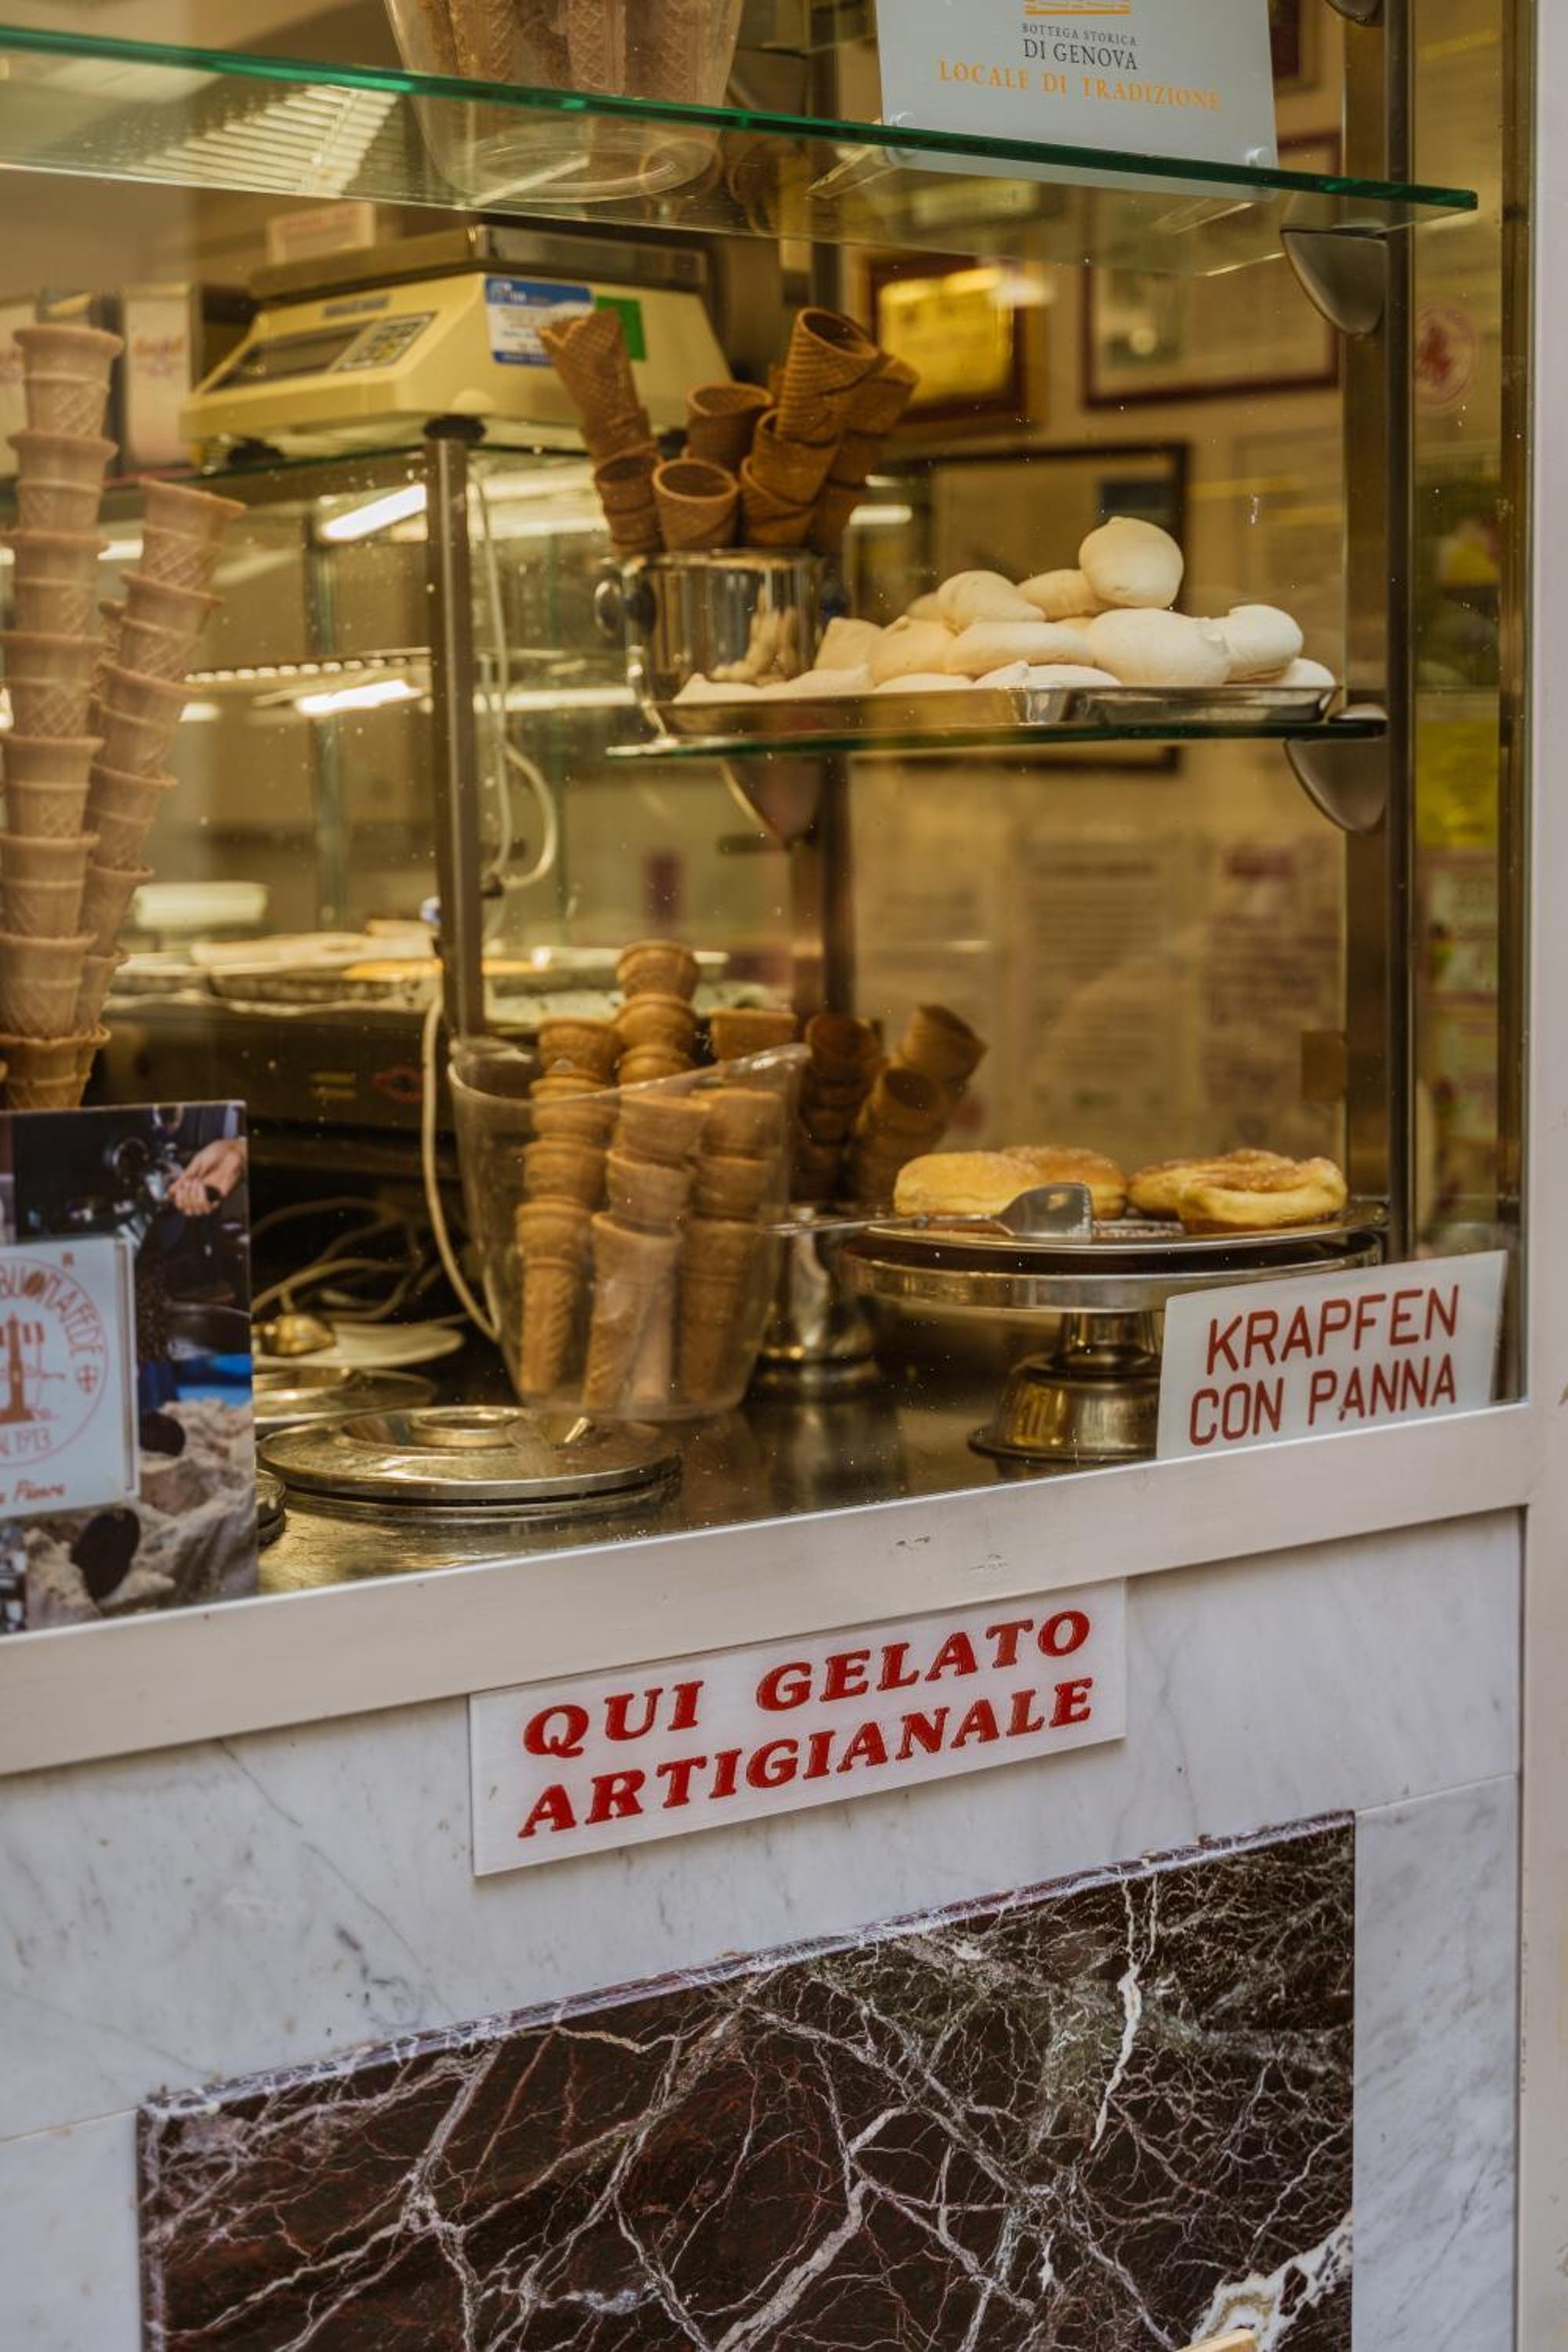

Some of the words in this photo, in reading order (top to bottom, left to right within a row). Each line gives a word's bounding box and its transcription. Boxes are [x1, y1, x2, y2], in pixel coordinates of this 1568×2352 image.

[1022, 23, 1079, 39] BOTTEGA
[1083, 31, 1137, 46] STORICA
[1024, 38, 1045, 60] DI
[1053, 43, 1138, 70] GENOVA
[938, 59, 1029, 89] LOCALE
[1044, 73, 1067, 93] DI
[1080, 76, 1223, 111] TRADIZIONE
[1206, 1283, 1460, 1375] KRAPFEN
[1189, 1377, 1285, 1446] CON
[1308, 1352, 1457, 1426] PANNA
[522, 1680, 705, 1759] QUI
[755, 1610, 1091, 1712] GELATO
[517, 1677, 1094, 1839] ARTIGIANALE
